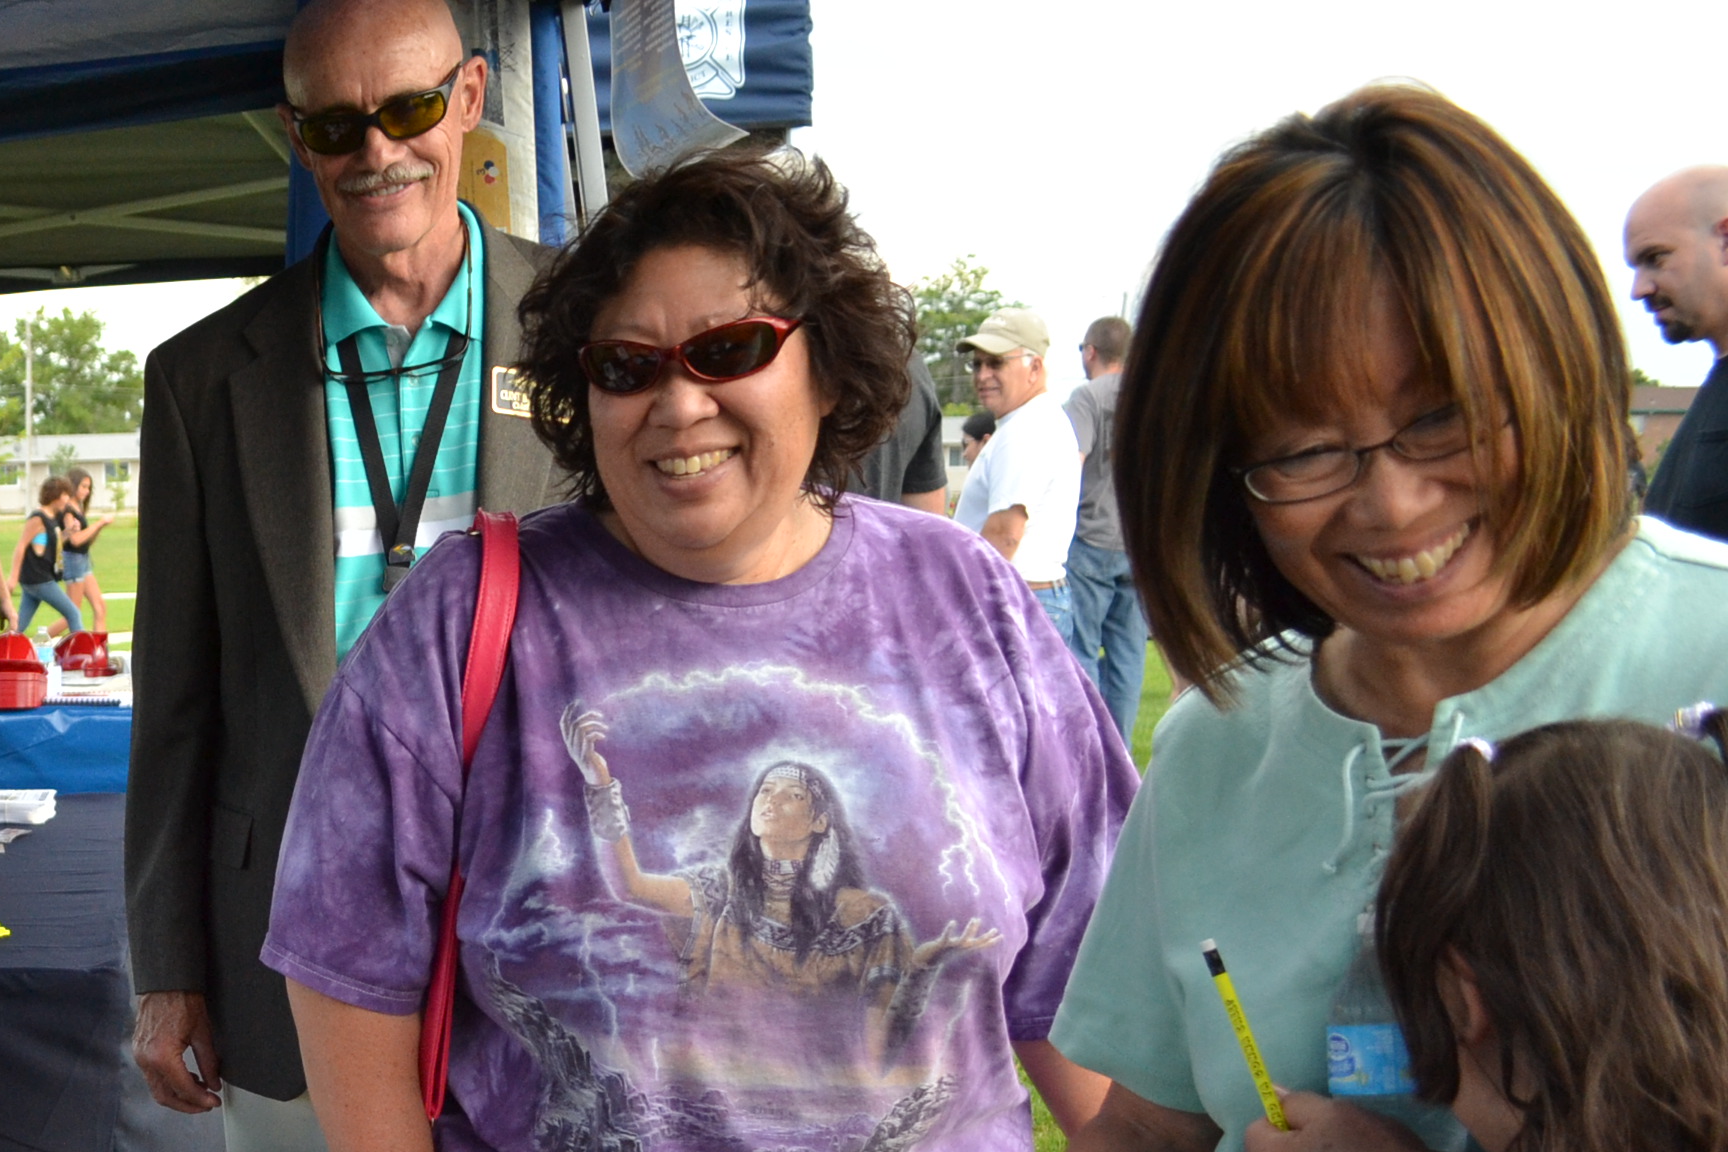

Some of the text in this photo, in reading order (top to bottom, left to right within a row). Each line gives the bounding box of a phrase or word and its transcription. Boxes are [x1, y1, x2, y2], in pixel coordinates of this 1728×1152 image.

[1240, 1034, 1265, 1079] GONNA
[1258, 1080, 1272, 1098] YA
[1267, 1102, 1284, 1131] WHO
